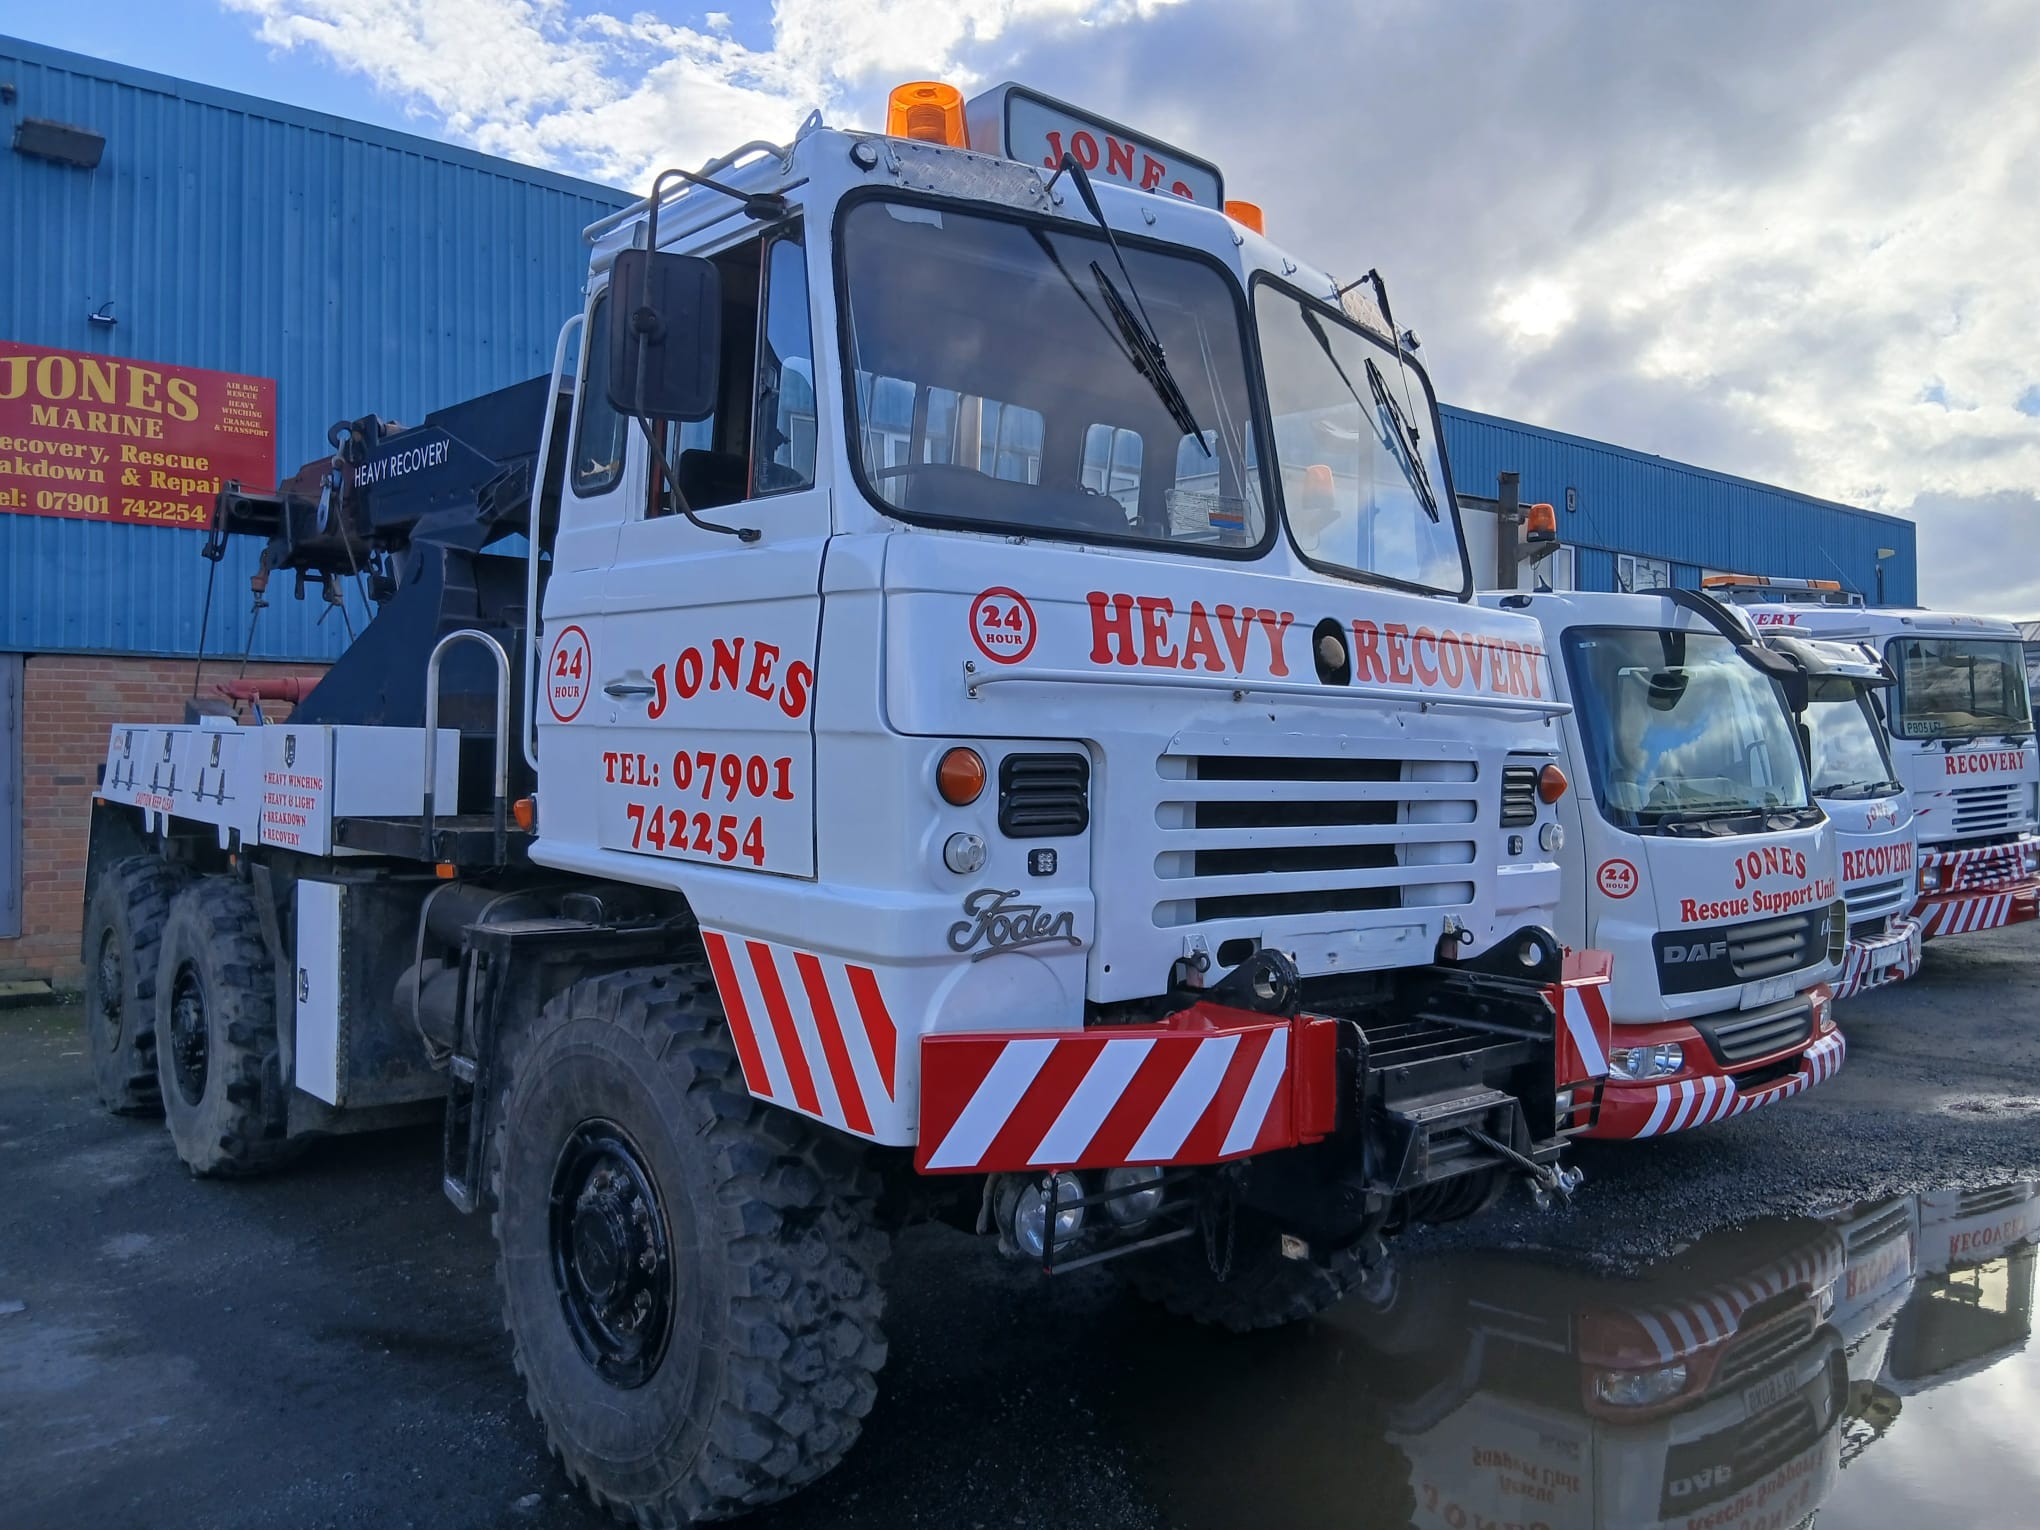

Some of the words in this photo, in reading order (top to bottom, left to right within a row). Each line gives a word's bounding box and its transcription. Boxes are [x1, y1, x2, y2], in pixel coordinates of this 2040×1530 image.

[0, 356, 199, 421] JONES
[226, 382, 241, 390] AIR
[243, 384, 259, 392] BAG
[227, 390, 257, 400] RESCUE
[222, 407, 262, 418] WINCHING
[228, 400, 255, 409] HEAVY
[30, 404, 164, 440] MARINE
[223, 425, 270, 437] TRANSPORT
[224, 417, 260, 428] CRANAGE
[0, 436, 110, 464] ecovery,
[120, 444, 209, 471] Rescue
[354, 457, 388, 489] HEAVY
[390, 439, 450, 478] RECOVERY
[0, 456, 105, 483] akdown
[121, 468, 141, 487] &
[150, 470, 221, 496] Repai
[0, 488, 27, 508] el:
[36, 490, 110, 514] 07901
[121, 498, 207, 523] 742254
[982, 605, 1023, 631] 24
[986, 633, 1023, 645] HOUR
[1086, 591, 1294, 676] HEAVY
[1351, 619, 1542, 699] RECOVERY
[555, 647, 582, 679] 24
[647, 637, 813, 719] JONES
[555, 686, 580, 698] HOUR
[603, 752, 659, 787] TEL:
[673, 750, 794, 802] 07901
[1944, 752, 2024, 775] RECOVERY
[267, 772, 287, 786] HEAVY
[289, 774, 323, 791] WINCHING
[267, 792, 287, 806] HEAVY
[295, 796, 315, 810] LIGHT
[267, 811, 306, 827] BREAKDOWN
[267, 828, 300, 846] RECOVERY
[627, 803, 765, 866] 742254
[1734, 847, 1806, 889] JONES
[1842, 841, 1913, 881] RECOVERY
[1605, 868, 1630, 881] 24
[1680, 898, 1749, 922] Rescue
[1753, 884, 1812, 913] Support
[1815, 877, 1835, 900] Unit
[948, 889, 1081, 963] Foden
[1664, 941, 1727, 964] DAF
